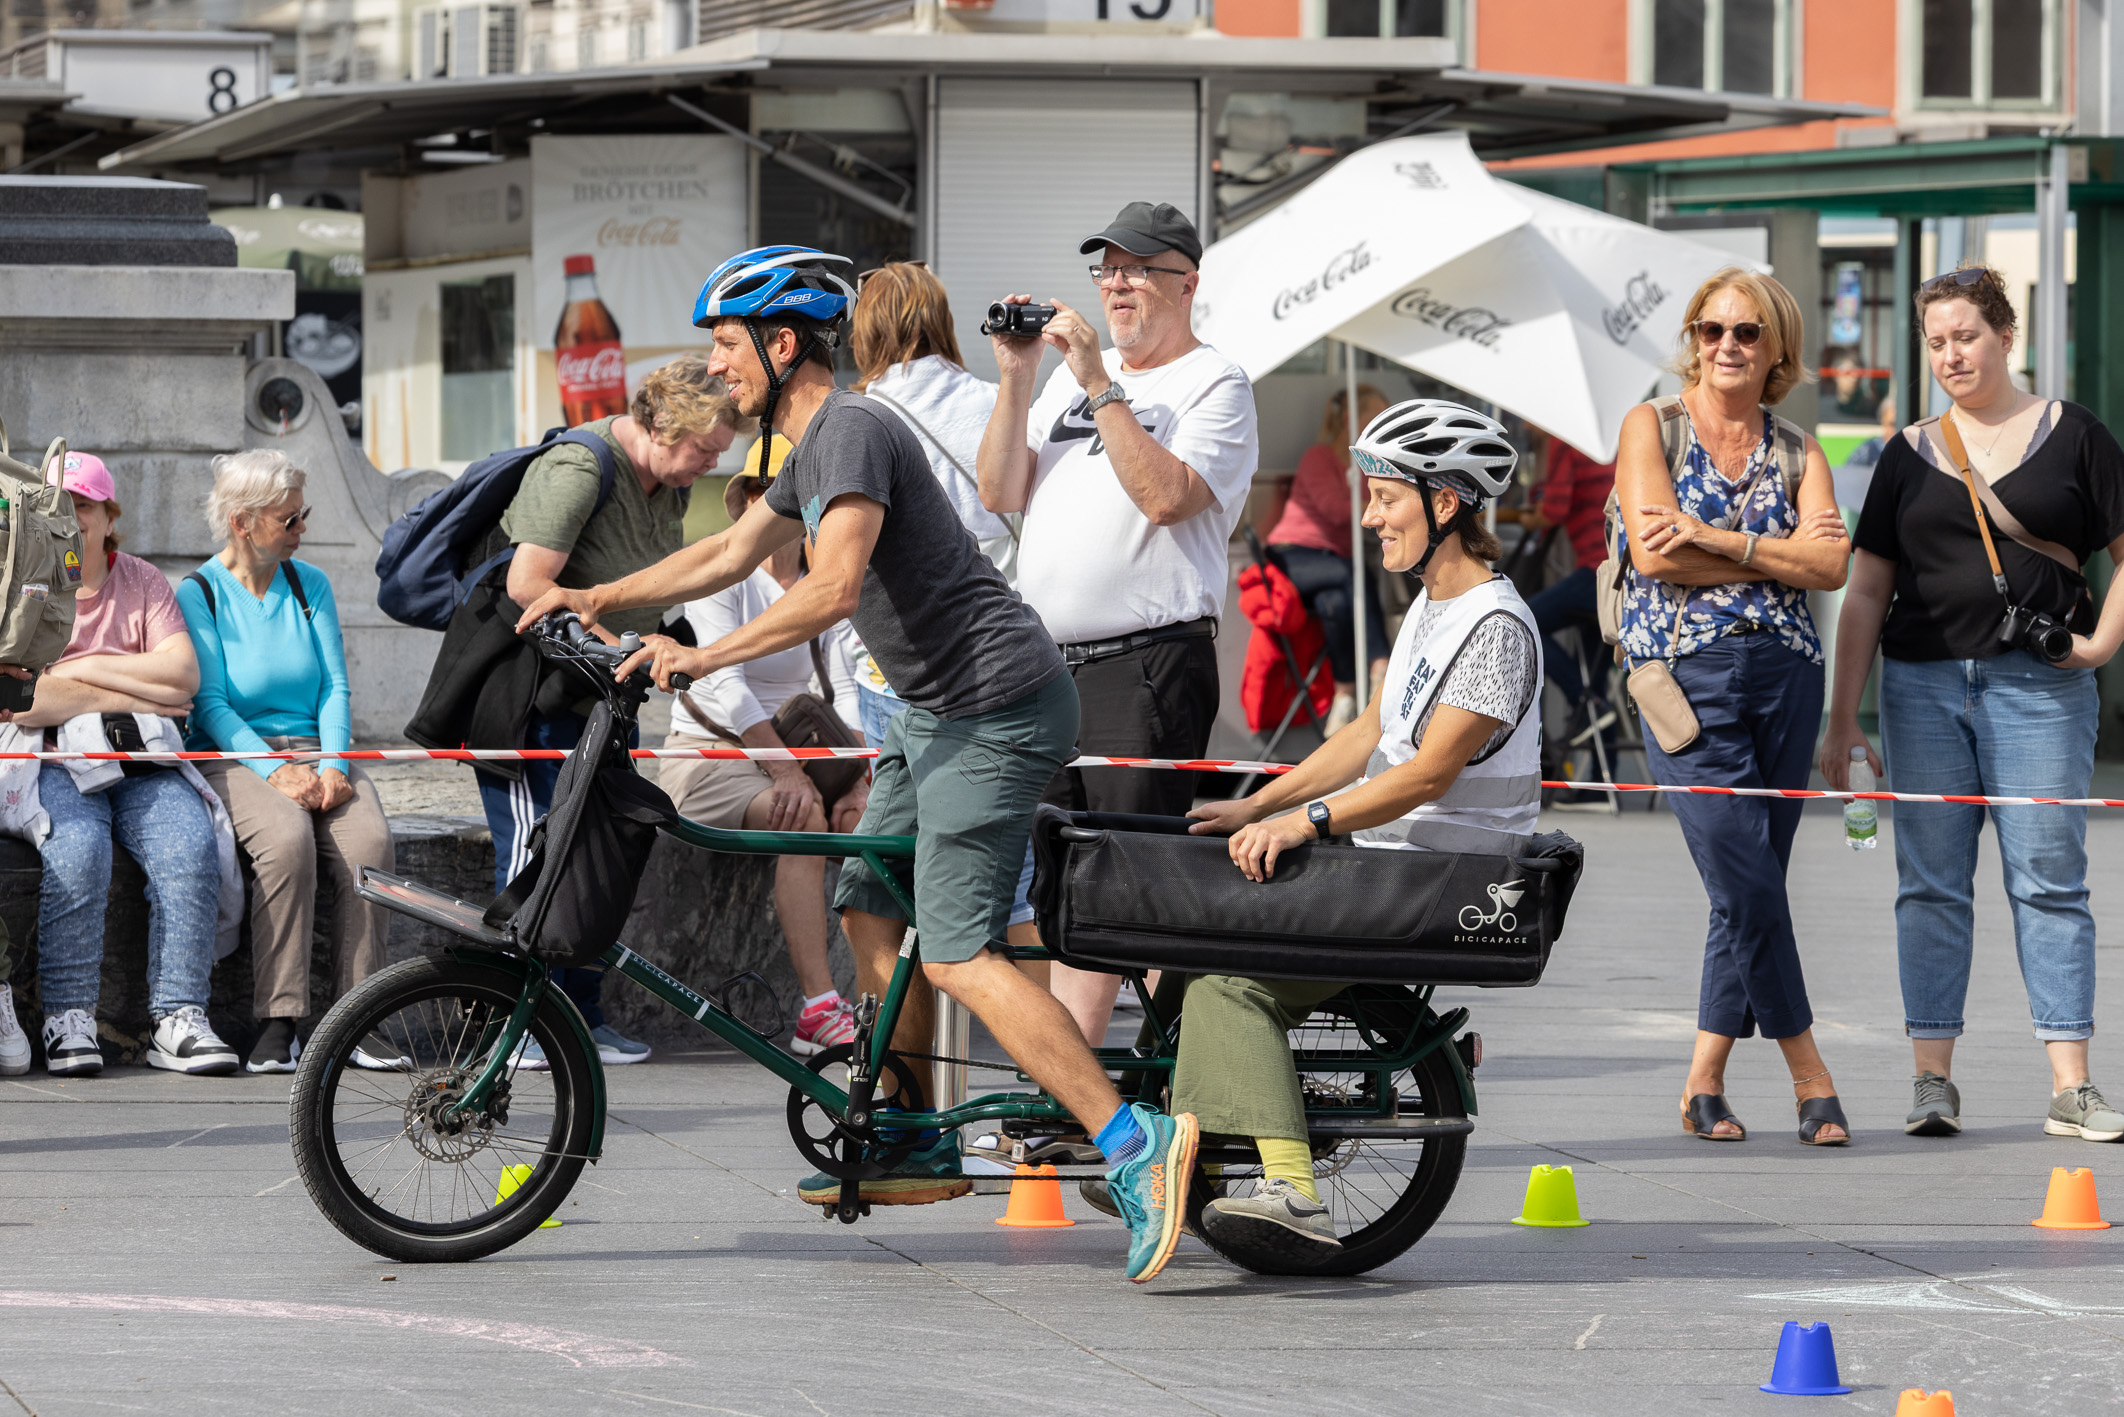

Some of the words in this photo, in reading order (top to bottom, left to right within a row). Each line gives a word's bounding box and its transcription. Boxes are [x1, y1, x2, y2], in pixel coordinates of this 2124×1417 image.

[208, 67, 237, 114] 8
[573, 179, 708, 202] BRÖTCHEN
[784, 293, 812, 304] BBB
[1486, 459, 1504, 467] BELL
[1454, 935, 1528, 944] BICICAPACE
[633, 955, 700, 1003] BICICAPACE
[1150, 1163, 1166, 1209] HOKA
